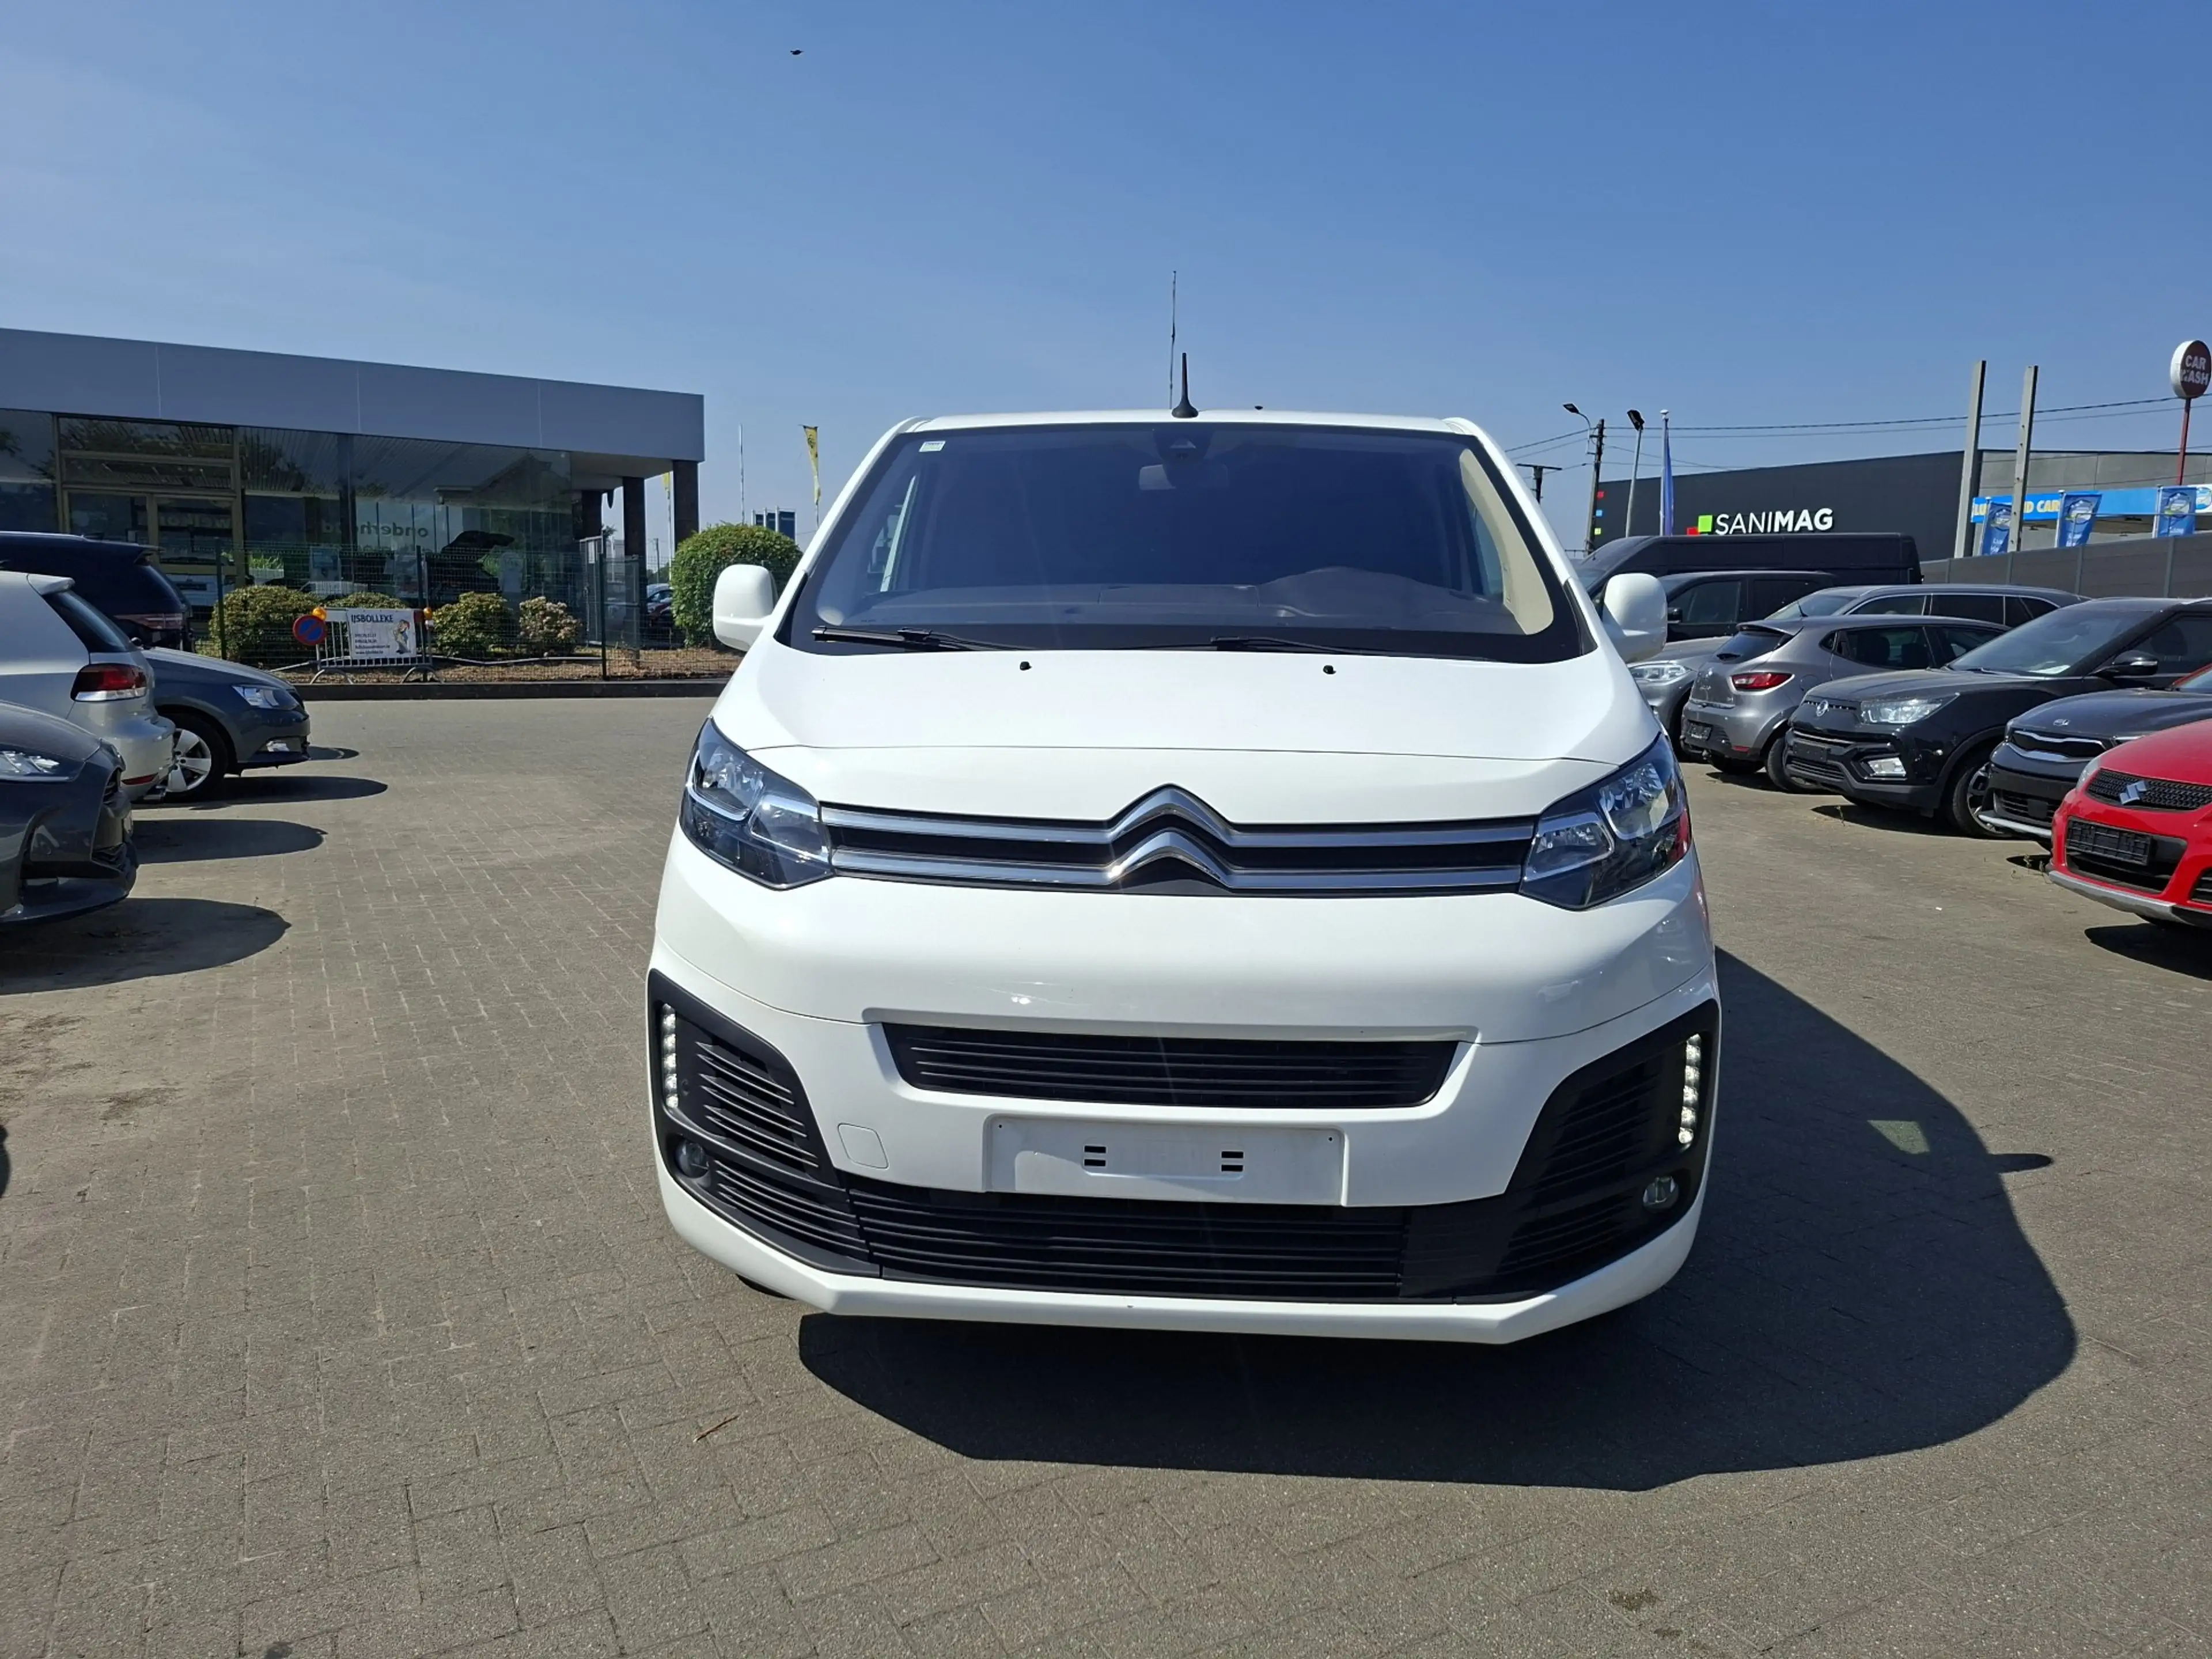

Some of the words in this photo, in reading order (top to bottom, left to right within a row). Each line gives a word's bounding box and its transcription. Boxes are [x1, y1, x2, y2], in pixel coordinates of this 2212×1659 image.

[2185, 354, 2207, 370] CAR
[1715, 507, 1833, 535] SANIMAG
[351, 614, 394, 623] IJSBOLLEKE
